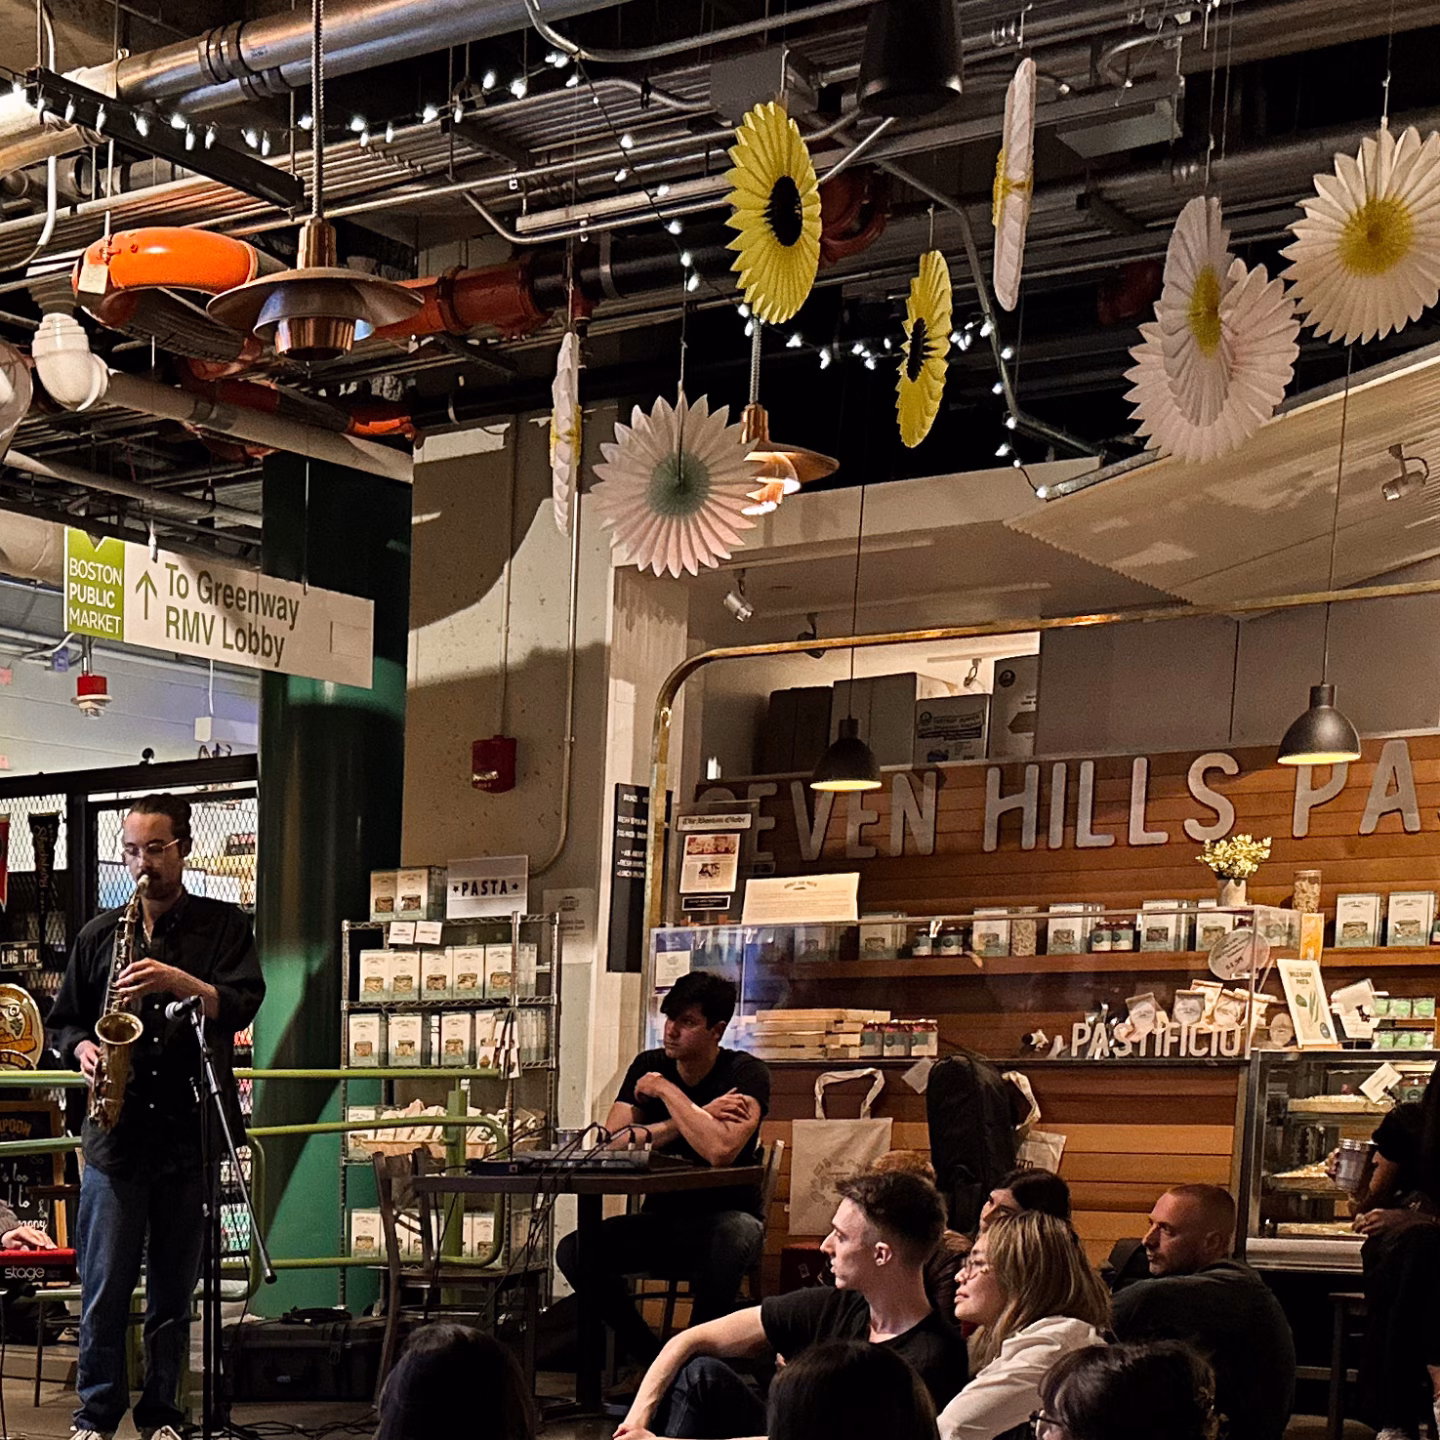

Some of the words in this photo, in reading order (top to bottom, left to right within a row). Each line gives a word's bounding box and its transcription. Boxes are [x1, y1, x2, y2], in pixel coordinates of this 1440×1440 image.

[69, 557, 122, 587] BOSTON
[69, 582, 115, 609] PUBLIC
[165, 562, 189, 599] To
[197, 569, 300, 630] Greenway
[69, 607, 121, 634] MARKET
[166, 605, 215, 646] RMV
[222, 617, 286, 668] Lobby
[983, 751, 1241, 852] HILLS
[1292, 738, 1440, 838] PA
[461, 879, 509, 896] PASTA
[1070, 1022, 1243, 1057] PASTIFICIO
[4, 1266, 45, 1281] stage
